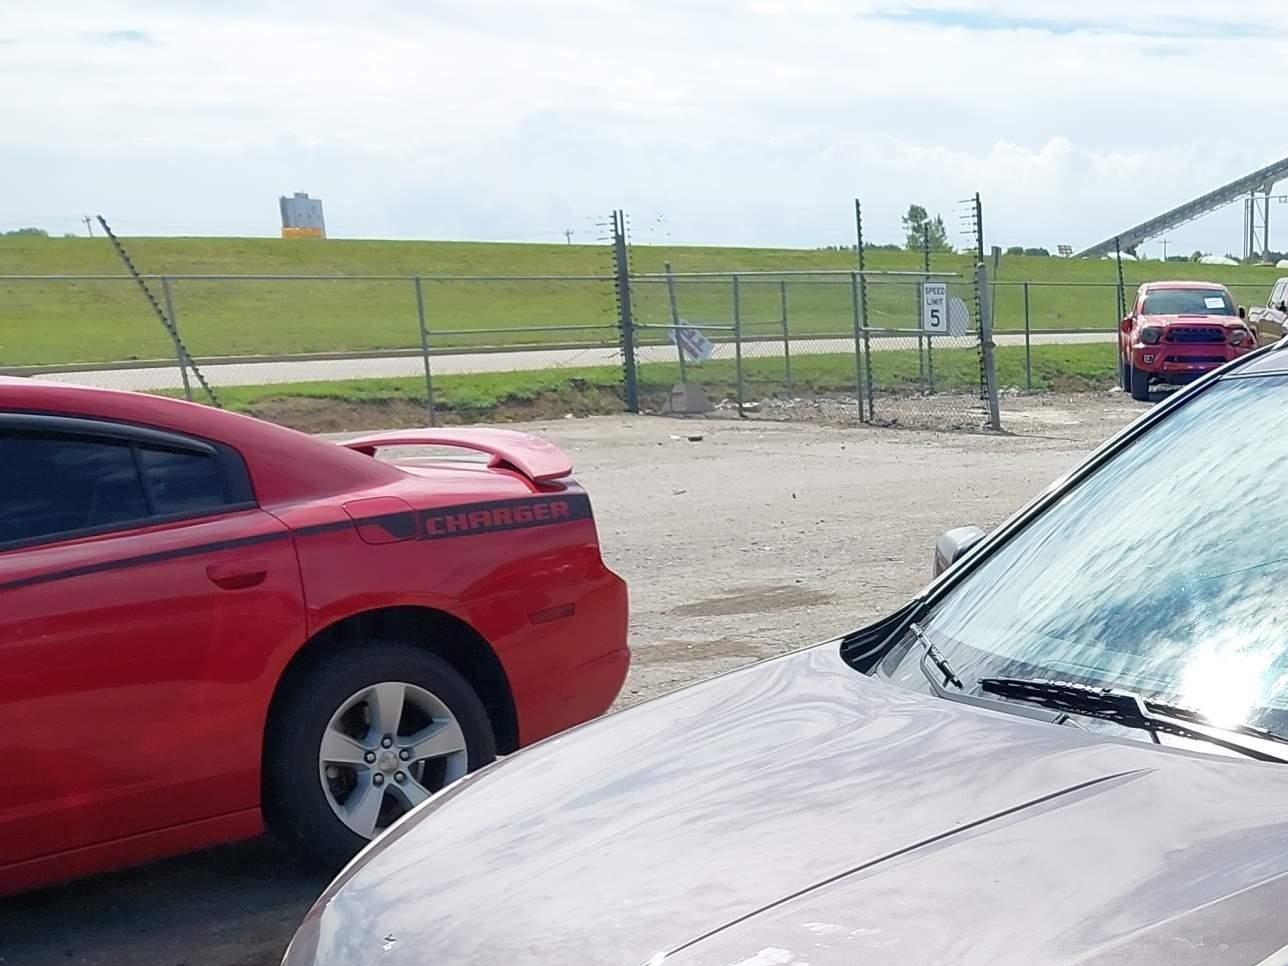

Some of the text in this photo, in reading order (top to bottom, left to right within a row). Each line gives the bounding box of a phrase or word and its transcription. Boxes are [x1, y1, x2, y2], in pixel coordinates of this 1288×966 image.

[925, 287, 945, 295] SPEED
[926, 298, 944, 306] LIMIT
[930, 308, 941, 328] 5
[425, 501, 572, 535] CHARGER
